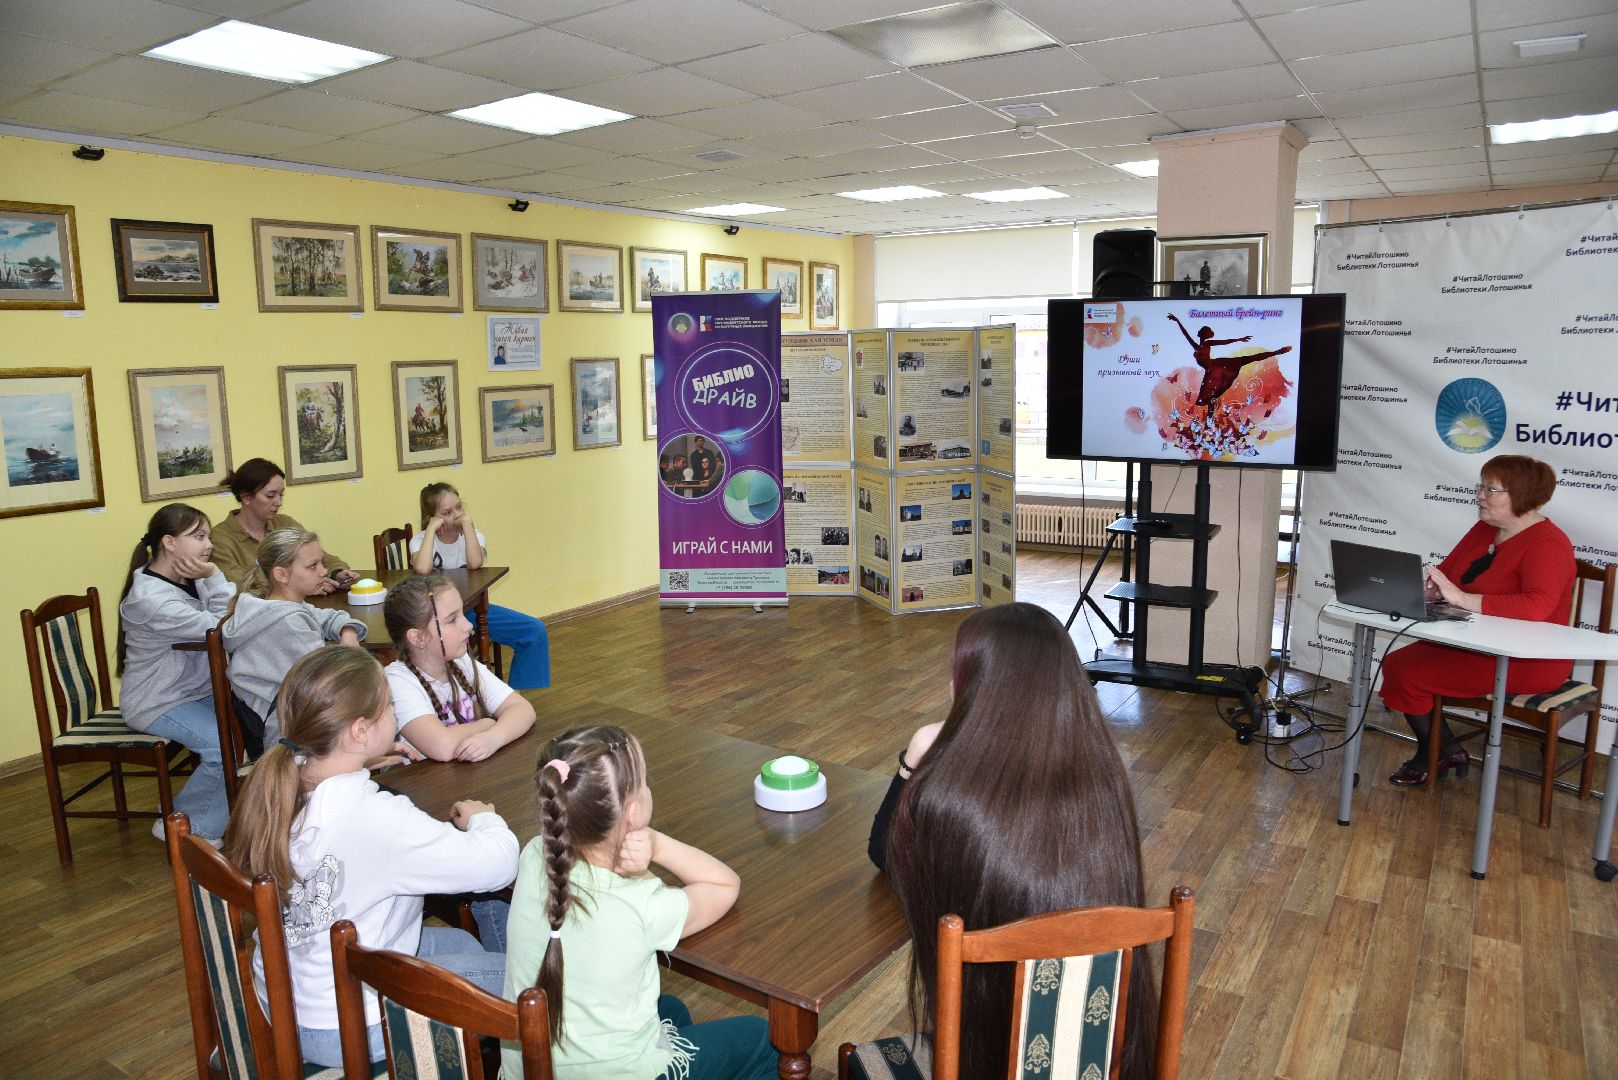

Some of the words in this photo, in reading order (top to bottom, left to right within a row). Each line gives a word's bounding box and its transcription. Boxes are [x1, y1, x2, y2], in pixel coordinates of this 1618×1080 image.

[1346, 251, 1409, 260] #ЧитайЛотошино
[1337, 263, 1376, 271] Библиотеки
[1377, 261, 1419, 269] Лотошинья
[1452, 273, 1523, 282] #ЧитайЛотошино
[1441, 286, 1487, 294] Библиотеки
[1488, 283, 1533, 292] Лотошинья
[1190, 309, 1233, 319] Балетный
[1235, 307, 1284, 320] брейн-ринг
[1561, 327, 1615, 335] Библиотеки
[1433, 356, 1480, 364] Библиотеки
[692, 364, 755, 392] БИБЛИО
[1098, 369, 1141, 378] призывный
[1341, 384, 1398, 392] ЧитайЛотошино
[693, 388, 757, 409] ДРАЙВ
[1367, 395, 1407, 403] Лотошинья
[1338, 448, 1393, 459] ЧитайЛотошино
[1363, 460, 1402, 470] Лотошинья
[1436, 484, 1477, 495] #ЧитайЛот
[1555, 479, 1601, 490] иблиотеки
[1423, 494, 1469, 505] Библиотеки
[1329, 511, 1388, 525] #ЧитайЛотошино
[1319, 518, 1357, 531] Библиотеки
[1358, 525, 1397, 536] Лотошинья
[672, 537, 717, 554] ИГРАЙ
[720, 540, 729, 554] С
[731, 540, 773, 554] НАМИ
